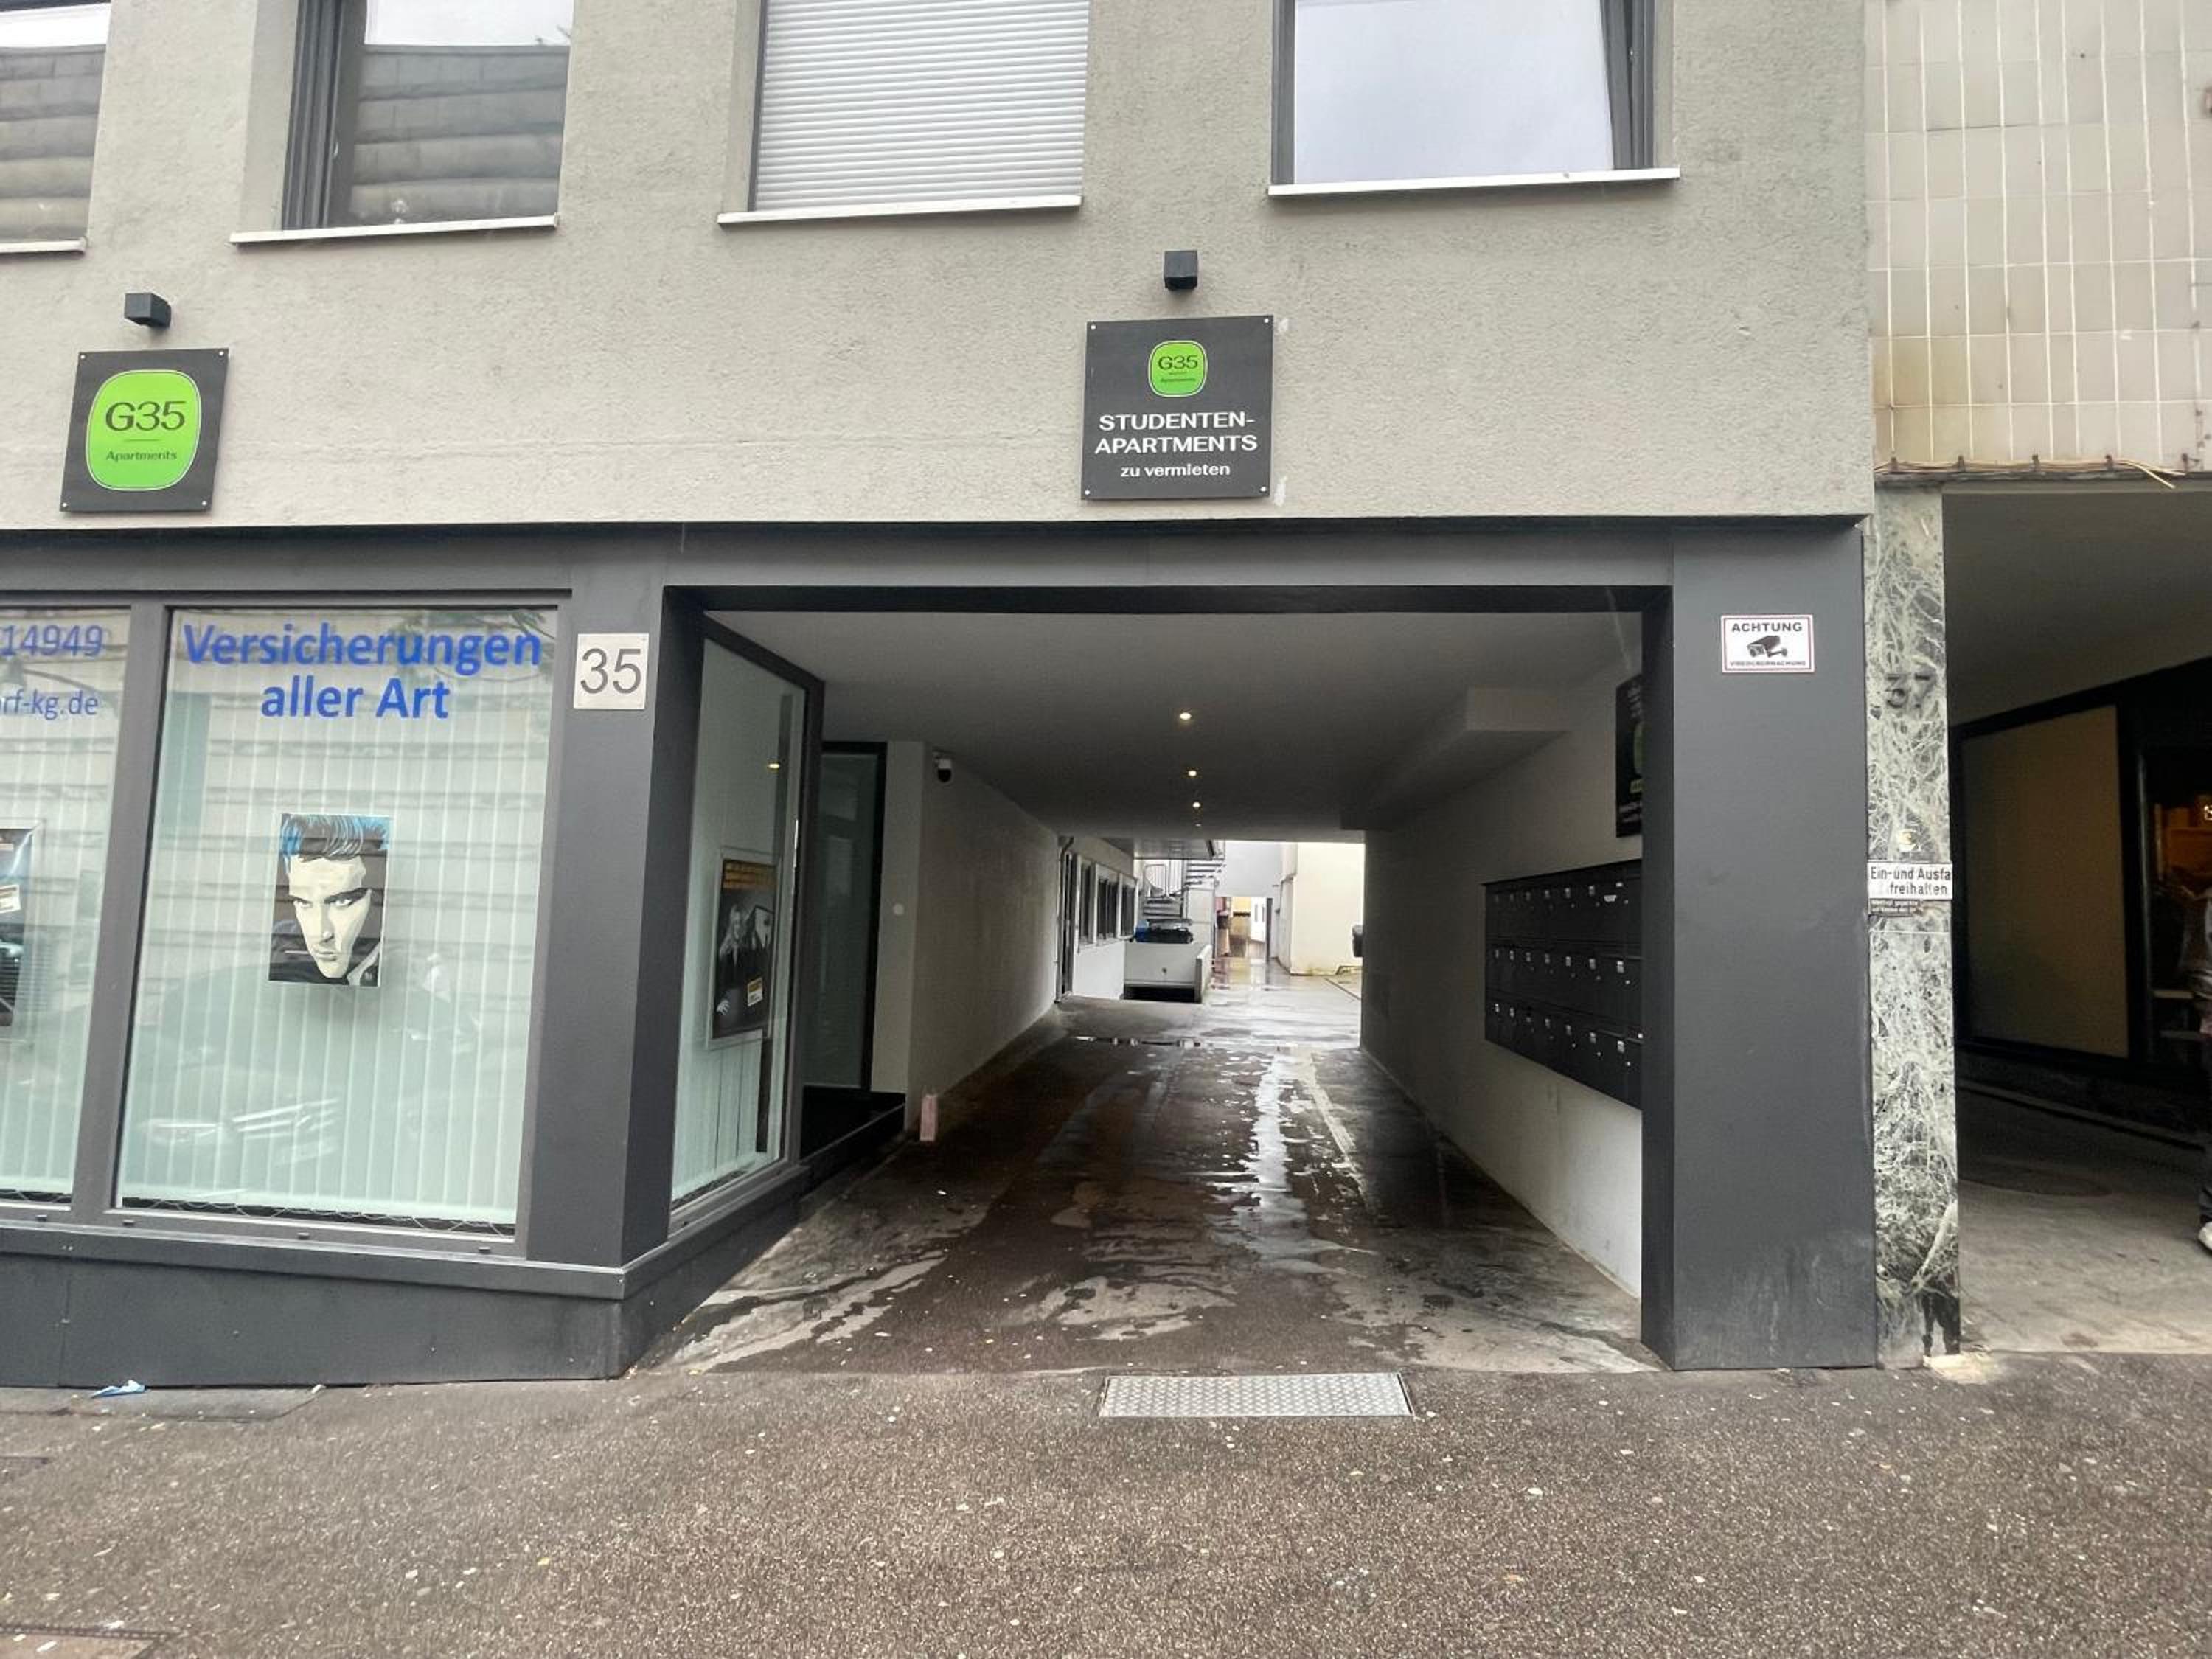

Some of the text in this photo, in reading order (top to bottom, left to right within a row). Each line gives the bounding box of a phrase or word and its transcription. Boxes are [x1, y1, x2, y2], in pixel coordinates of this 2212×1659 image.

[1158, 355, 1198, 369] G35
[105, 400, 187, 431] G35
[1099, 411, 1256, 431] STUDENTEN-
[1094, 434, 1258, 454] APARTMENTS
[105, 449, 178, 462] Apartments
[1120, 462, 1231, 477] zu vermieten
[1731, 622, 1803, 632] ACHTUNG
[183, 622, 543, 677] Versicherungen
[580, 648, 641, 694] 35
[0, 688, 99, 720] rf-kg.de
[260, 675, 451, 719] aller Art
[1890, 881, 1948, 895] freihalten
